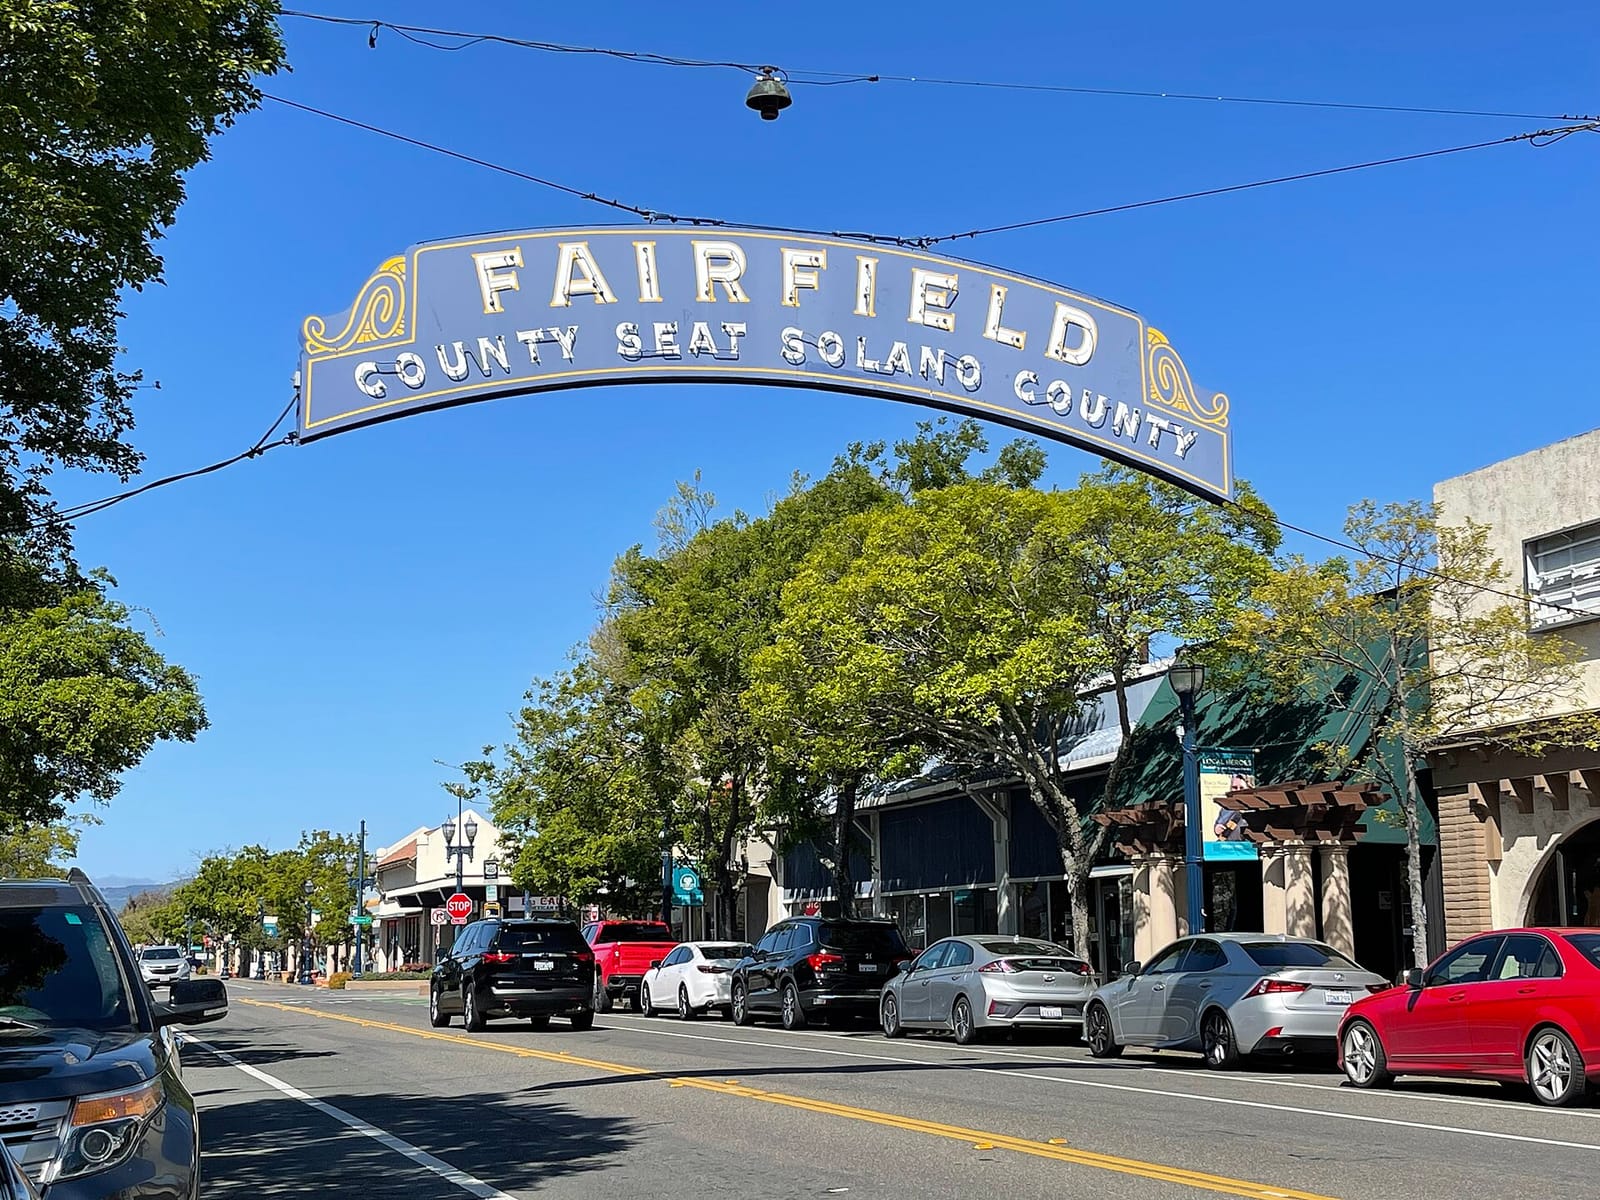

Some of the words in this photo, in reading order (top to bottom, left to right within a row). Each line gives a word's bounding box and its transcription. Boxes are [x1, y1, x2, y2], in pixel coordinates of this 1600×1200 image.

[471, 240, 1098, 366] FAIRFIELD
[353, 324, 579, 398] COUNTY
[614, 320, 748, 360] SEAT
[779, 325, 982, 392] SOLANO
[1013, 368, 1199, 459] COUNTY
[448, 901, 471, 912] STOP
